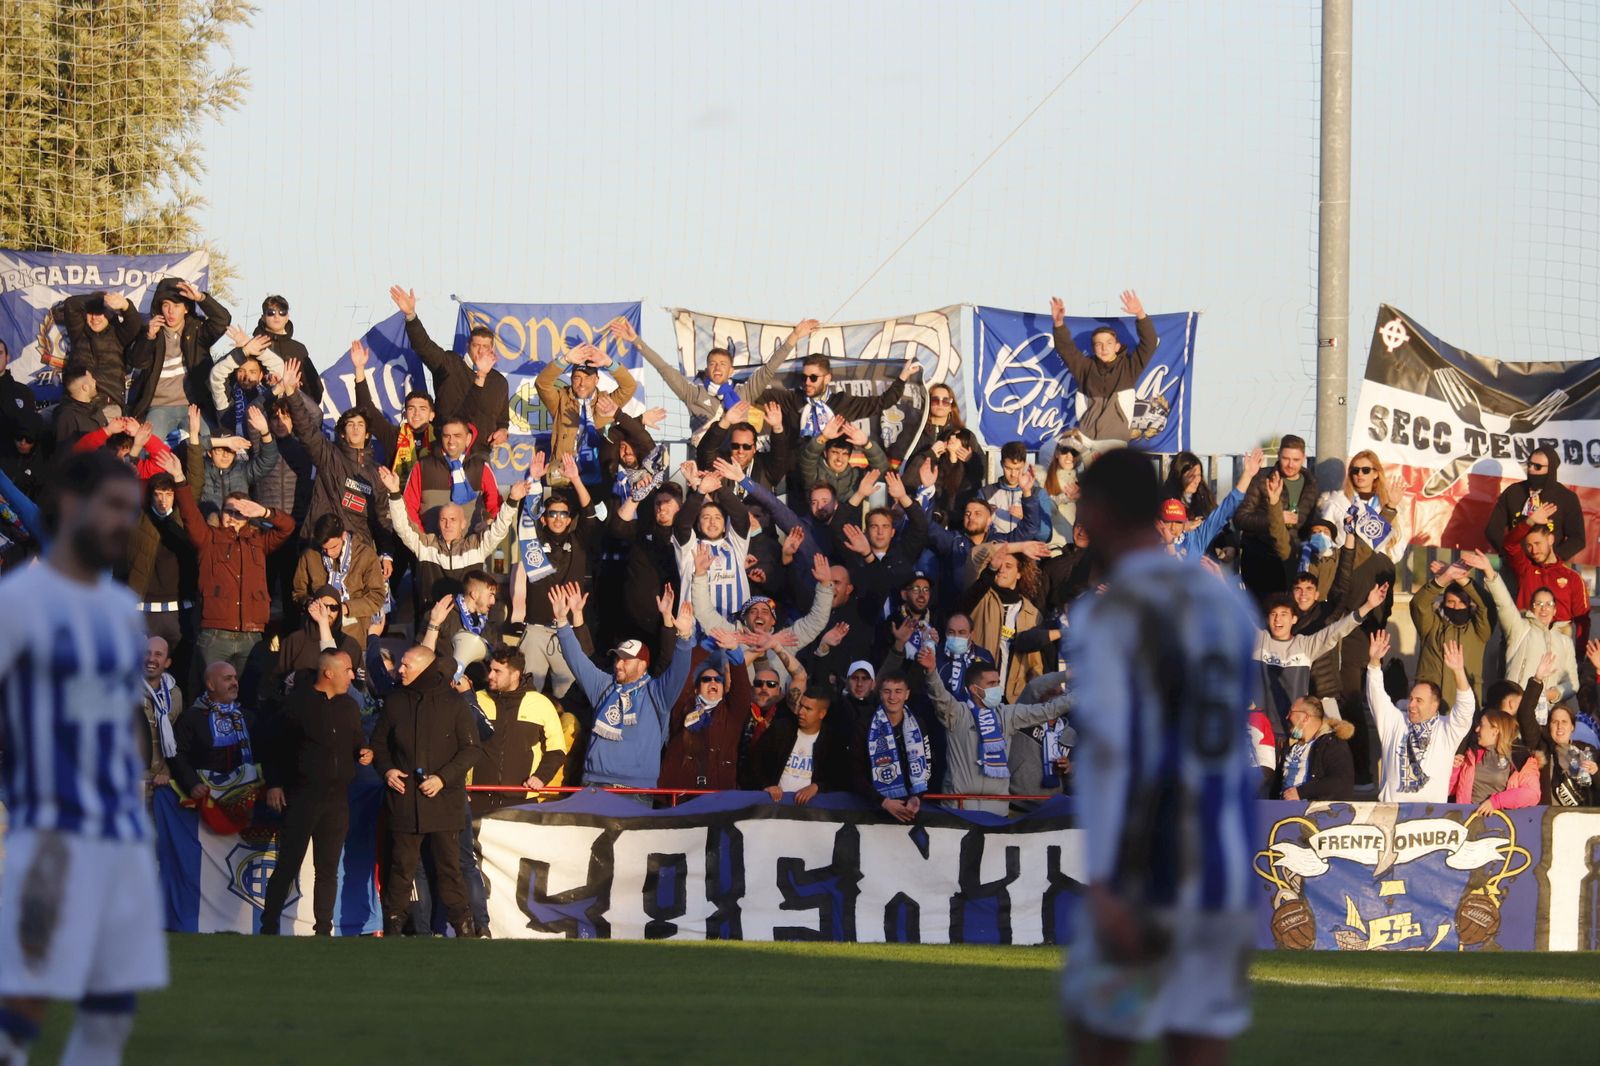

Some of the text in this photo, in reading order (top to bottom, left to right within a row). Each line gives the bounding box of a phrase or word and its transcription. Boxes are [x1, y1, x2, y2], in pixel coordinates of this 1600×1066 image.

[0, 265, 103, 293] RIGADA
[1368, 404, 1452, 454] SECC
[1318, 829, 1459, 850] FRENTE ONUBA
[478, 818, 1089, 944] FRENT
